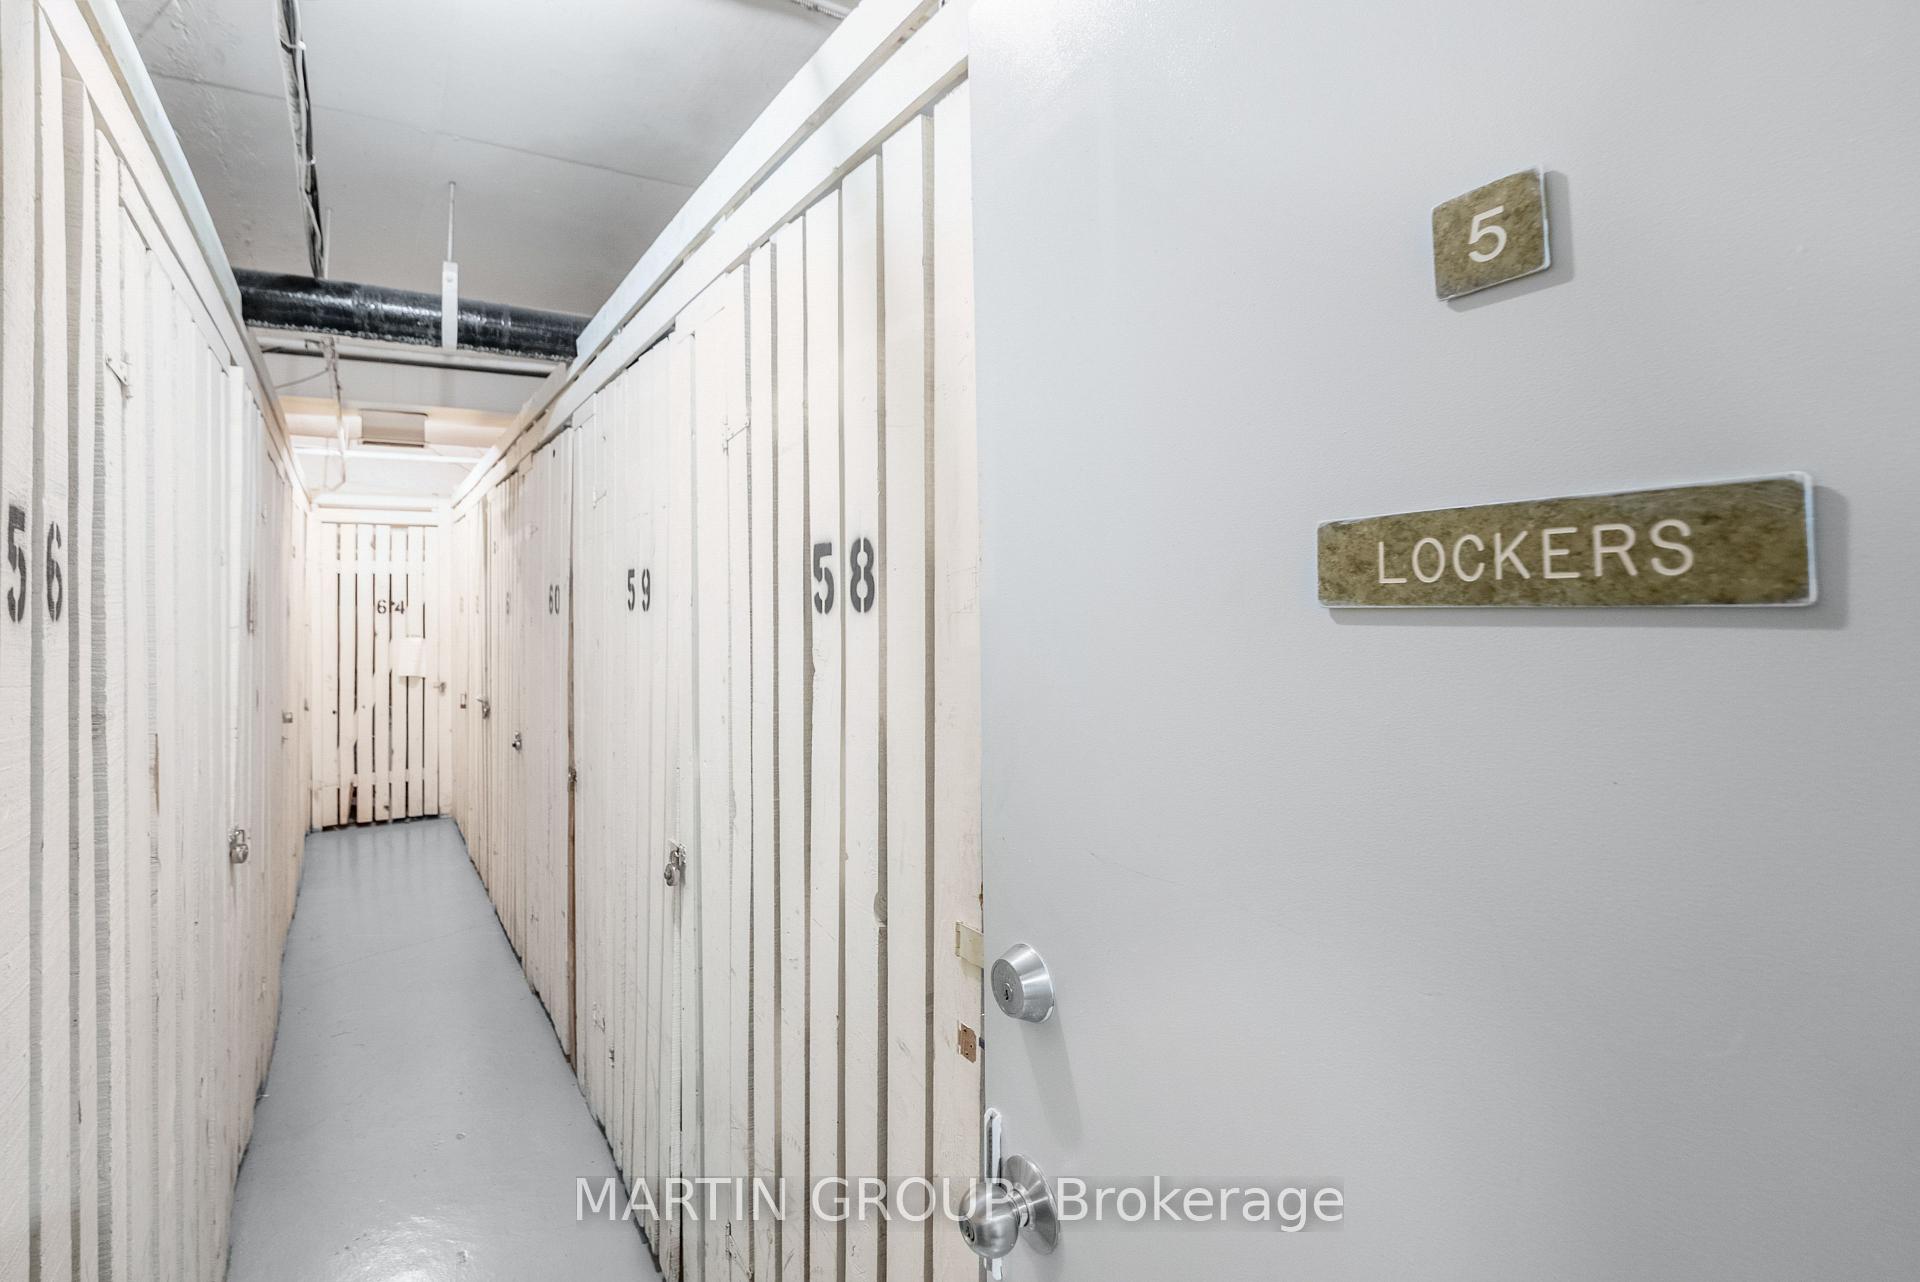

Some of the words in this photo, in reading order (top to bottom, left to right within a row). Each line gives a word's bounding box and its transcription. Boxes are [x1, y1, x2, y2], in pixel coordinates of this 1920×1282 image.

[1467, 205, 1508, 264] 5
[811, 536, 876, 615] 58
[1376, 518, 1695, 586] LOCKERS
[548, 584, 560, 615] 60
[627, 568, 652, 612] 59
